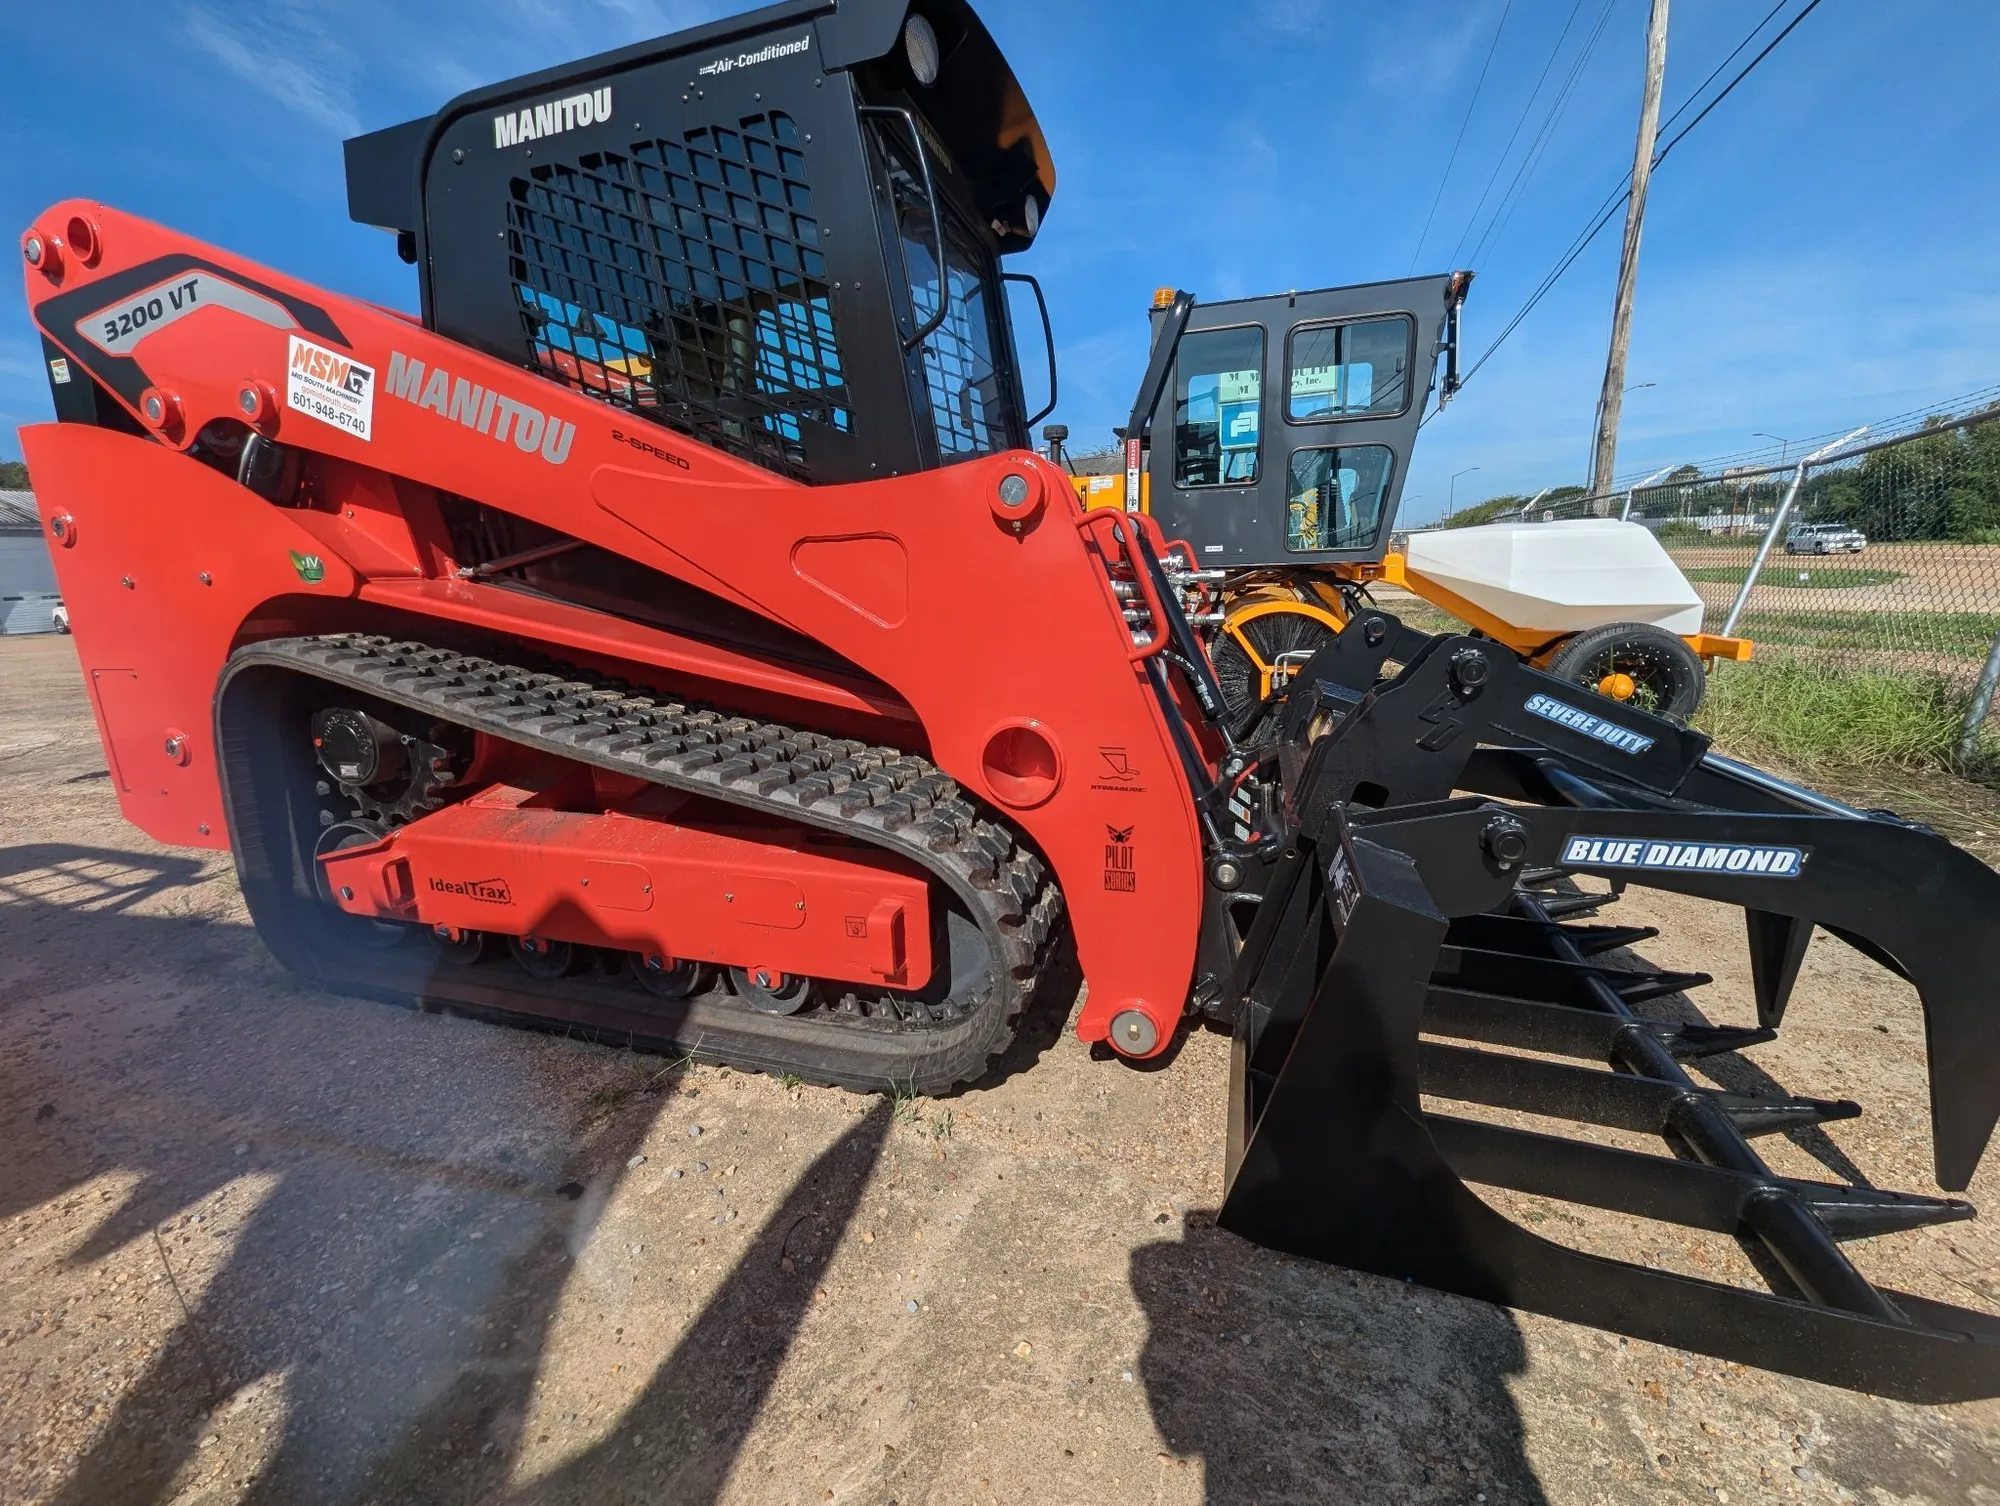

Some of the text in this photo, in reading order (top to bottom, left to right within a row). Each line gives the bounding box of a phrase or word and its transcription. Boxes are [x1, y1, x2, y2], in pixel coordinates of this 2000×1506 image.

[716, 35, 810, 74] Air-Conditioned
[494, 86, 612, 150] MANITOU
[104, 279, 199, 343] 3200 VT
[291, 342, 350, 389] MSM
[291, 370, 362, 406] MID SOUTH MACHINERY
[301, 386, 358, 414] gomidsouth.com
[384, 350, 577, 465] MANITOU
[293, 391, 366, 434] 601-948-6740
[611, 429, 690, 471] 2-SPEED
[1527, 695, 1650, 752] SEVERE DUTY
[1090, 784, 1145, 793] HYDRAGLIDE
[1105, 844, 1135, 870] PILOT
[1566, 839, 1643, 864] BLUE
[428, 877, 507, 900] IdealTrax
